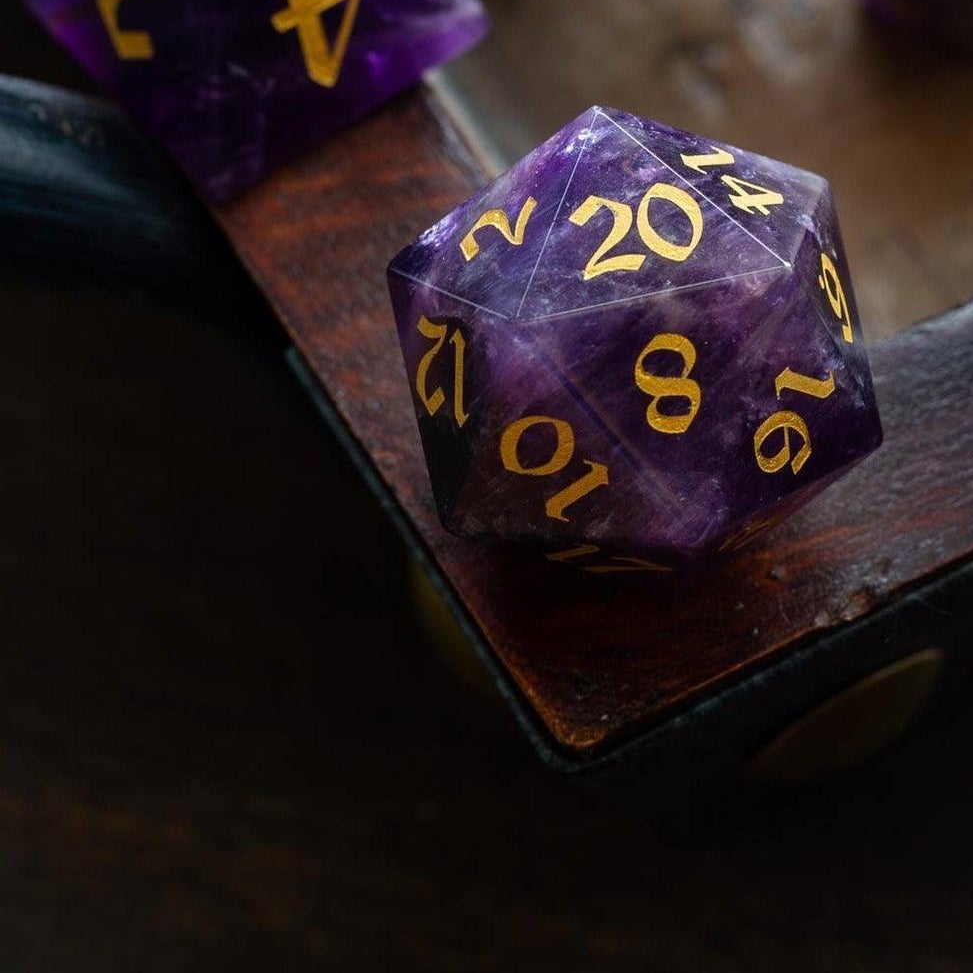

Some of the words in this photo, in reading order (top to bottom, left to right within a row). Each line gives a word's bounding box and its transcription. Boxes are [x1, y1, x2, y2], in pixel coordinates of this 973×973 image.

[459, 196, 538, 262] 2
[569, 182, 704, 281] 20
[681, 146, 785, 217] 14
[415, 315, 470, 428] 12
[634, 332, 702, 435] 8
[753, 366, 836, 475] 16
[499, 415, 610, 522] 10
